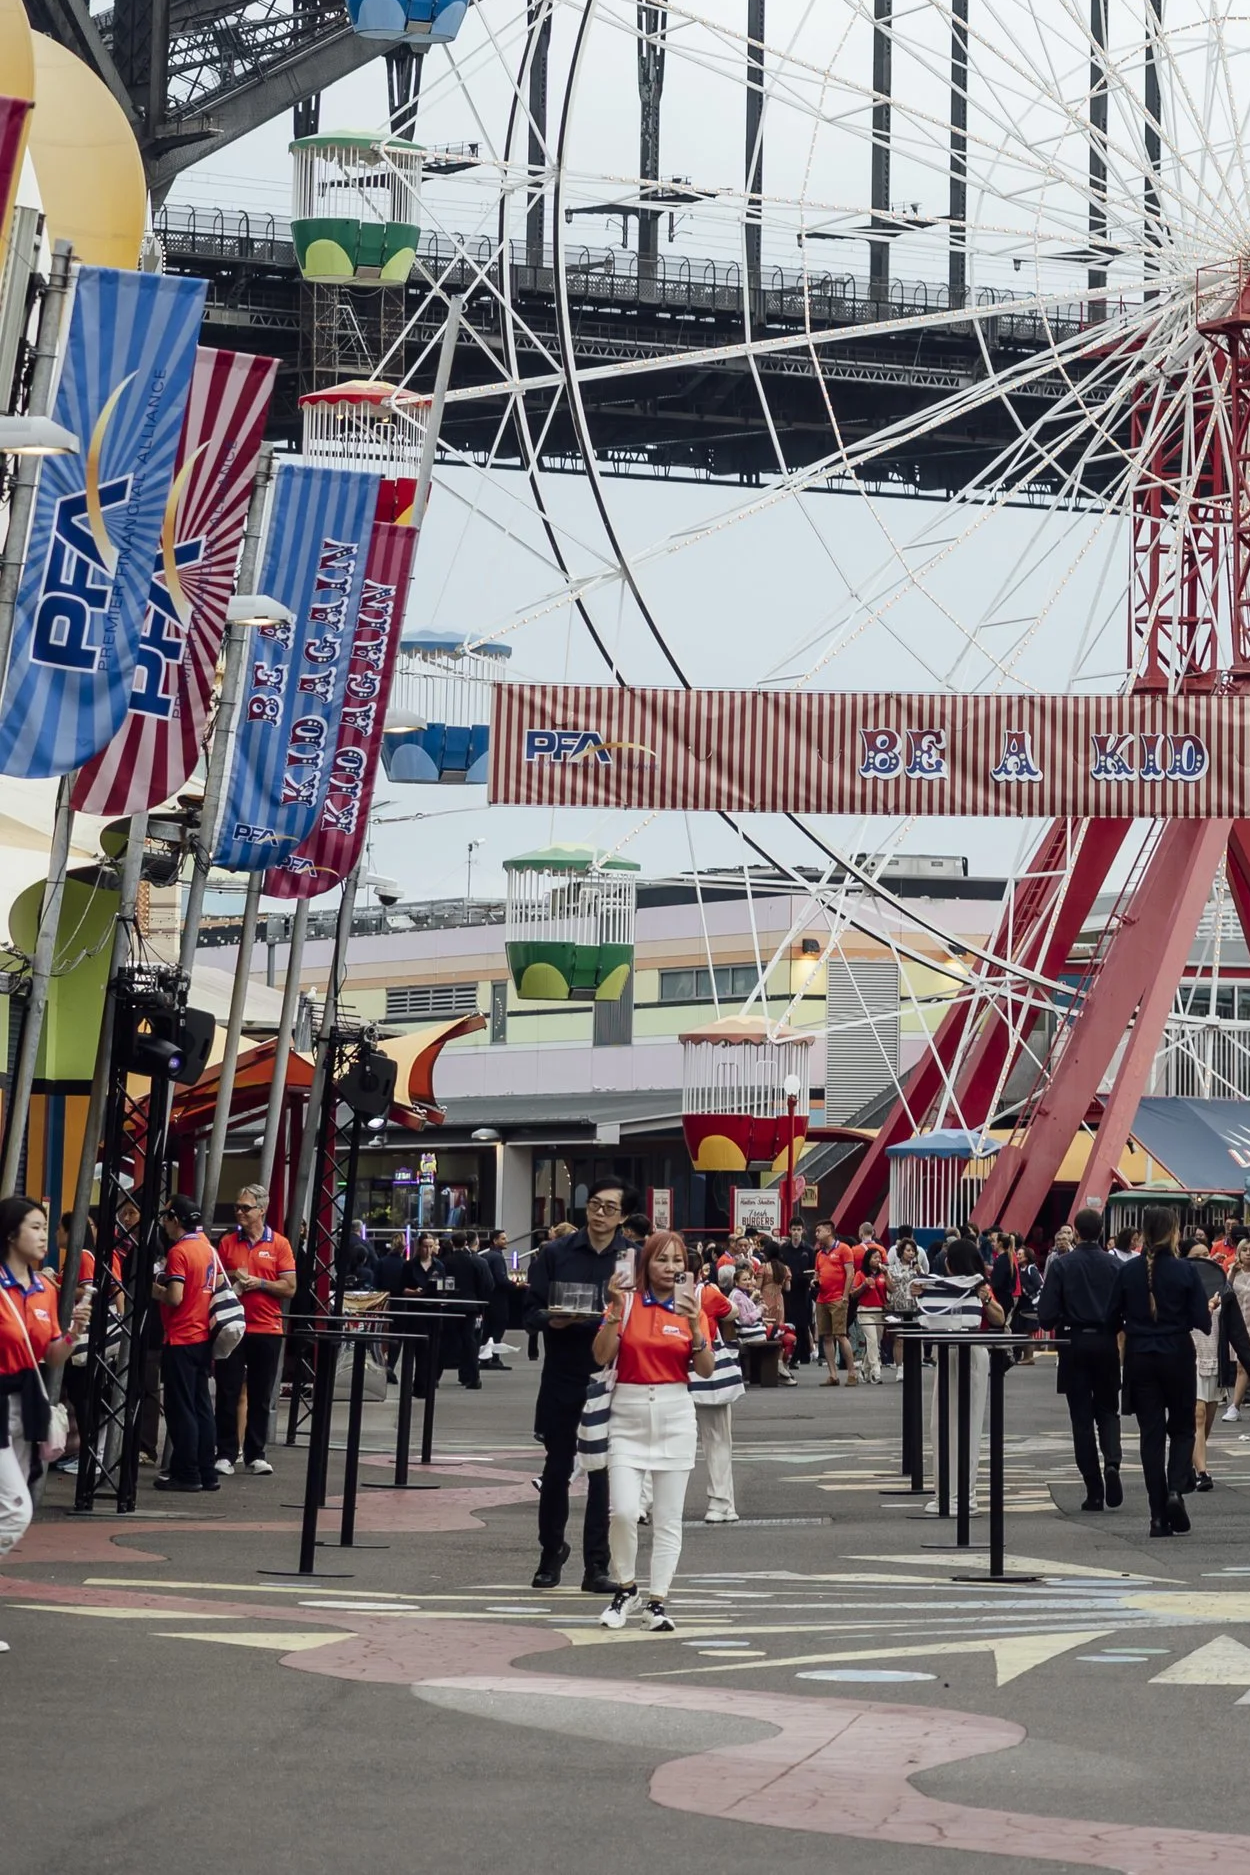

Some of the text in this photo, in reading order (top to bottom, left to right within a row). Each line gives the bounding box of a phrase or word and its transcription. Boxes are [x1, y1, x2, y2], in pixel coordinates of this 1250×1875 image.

[98, 368, 168, 672] PREMIER FINANCIAL ALLIANCE
[29, 472, 135, 675] PFA
[246, 661, 289, 728] BE
[280, 537, 359, 809] KID AGAIN
[320, 578, 398, 836] KID AGAIN
[524, 728, 613, 764] PFA
[858, 728, 948, 780] BE
[990, 730, 1043, 782] A
[1090, 733, 1210, 782] KID
[232, 823, 280, 847] PFA
[742, 1216, 775, 1226] BURGERS
